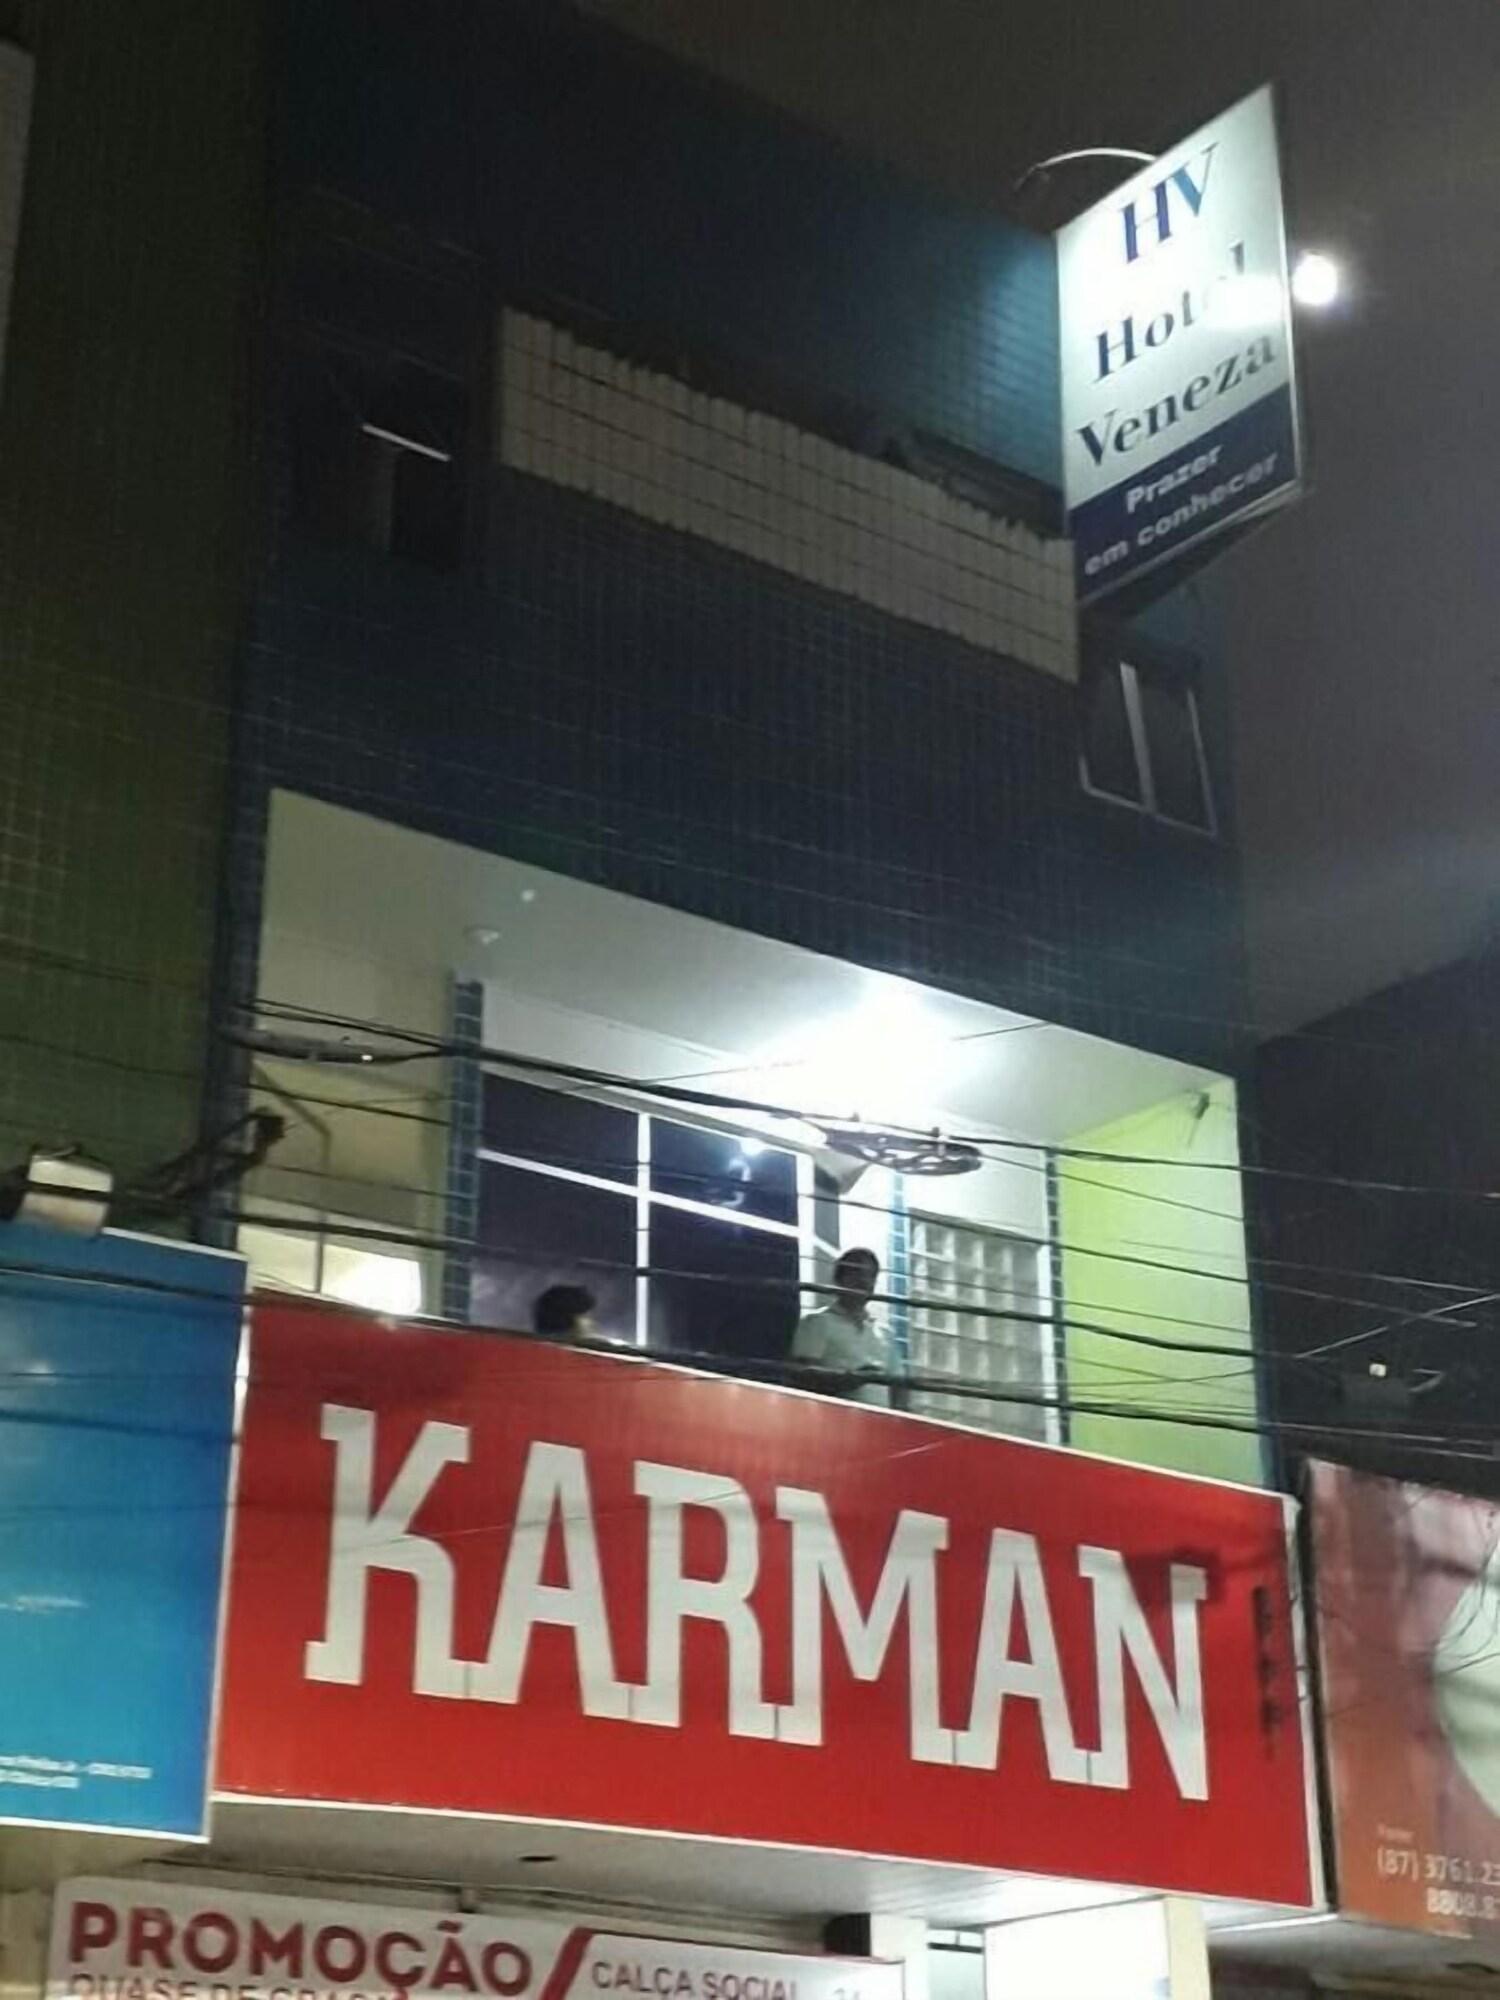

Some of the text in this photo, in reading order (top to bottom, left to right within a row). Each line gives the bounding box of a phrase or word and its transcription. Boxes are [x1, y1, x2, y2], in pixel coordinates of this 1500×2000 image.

[1118, 142, 1219, 264] HV
[1094, 240, 1246, 383] Hotl
[1076, 332, 1277, 467] Veneza
[1084, 452, 1278, 576] em conhecer
[1125, 444, 1222, 514] Prazer
[304, 1403, 1209, 1801] KARMAN
[68, 1901, 533, 2000] PROMOÇÃO
[591, 1961, 694, 1997] CALÇA
